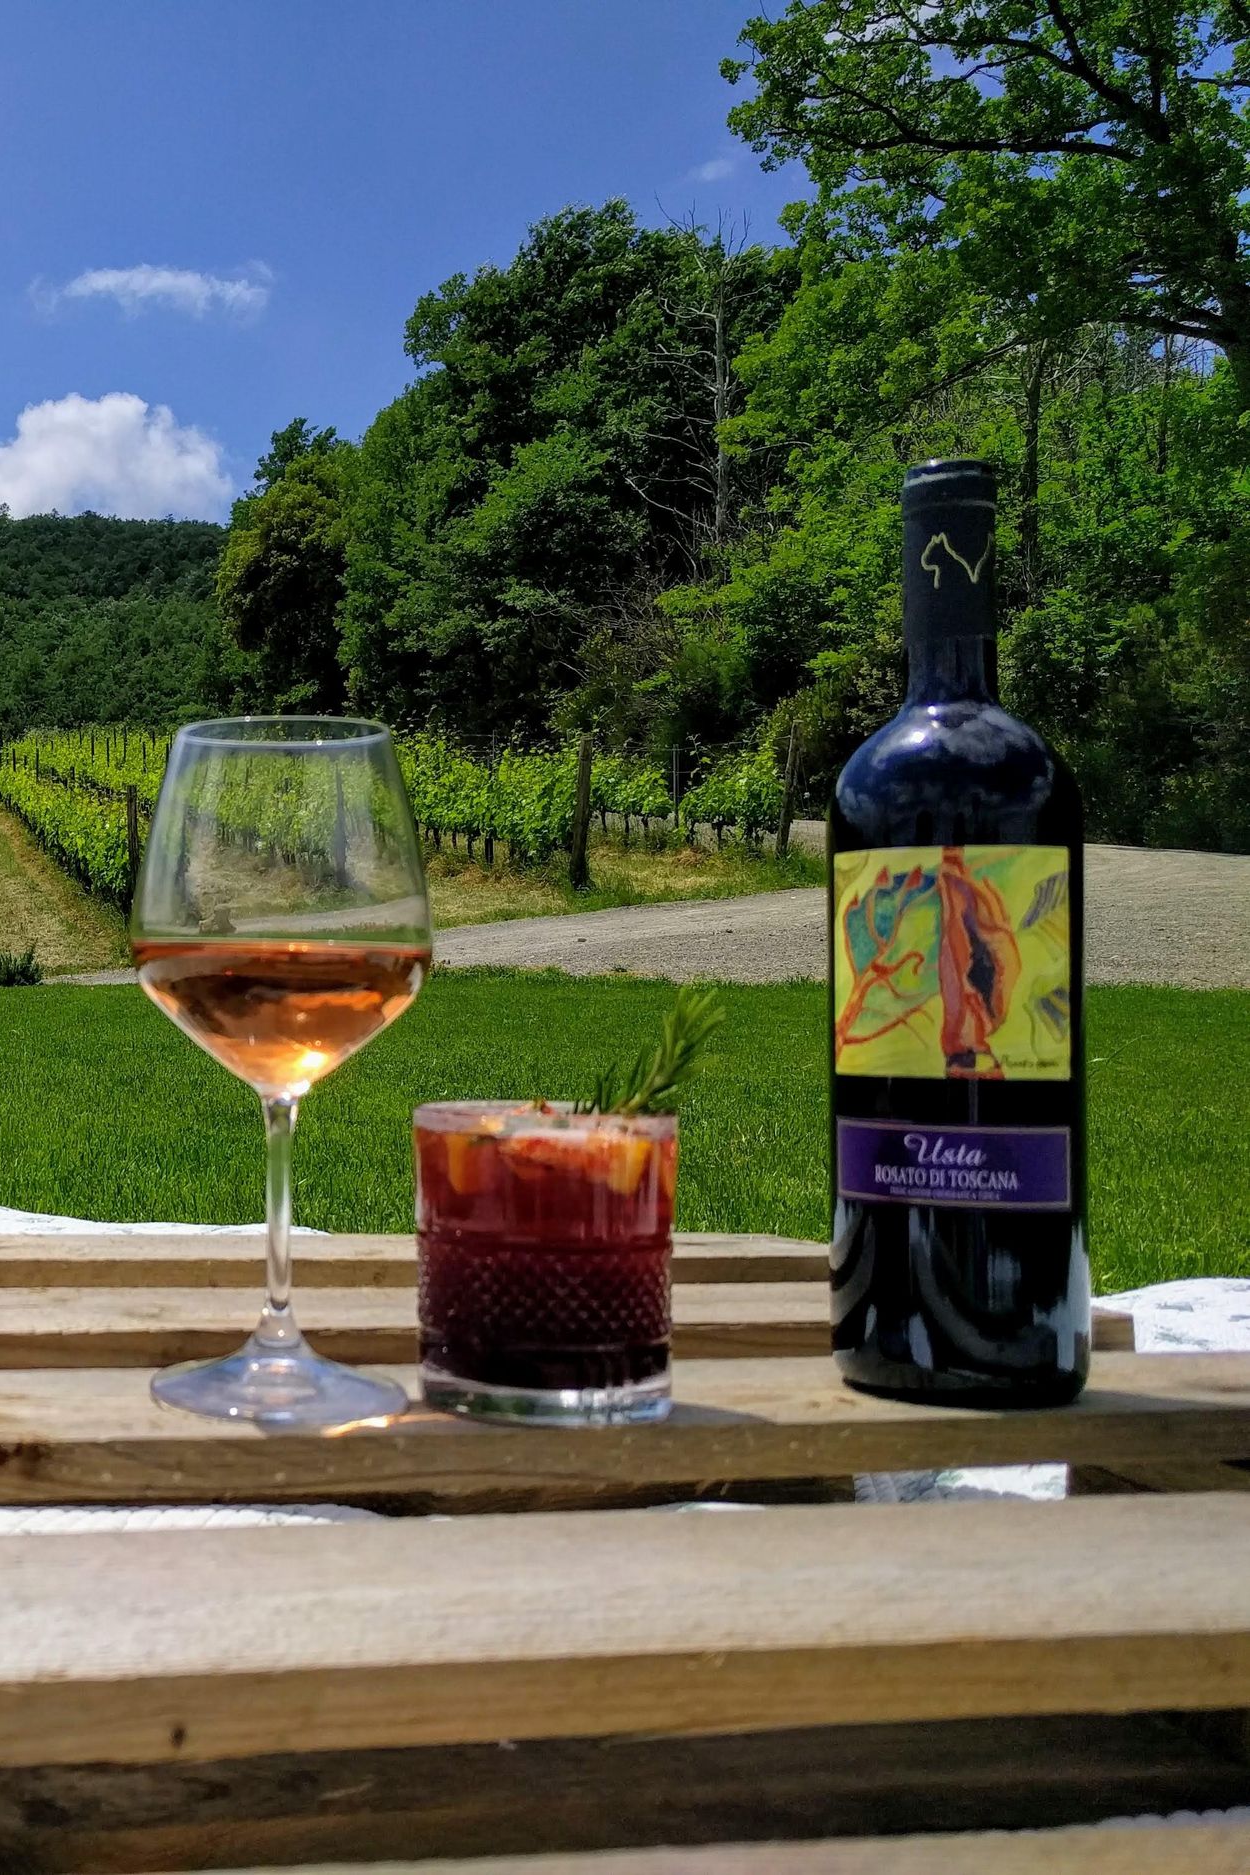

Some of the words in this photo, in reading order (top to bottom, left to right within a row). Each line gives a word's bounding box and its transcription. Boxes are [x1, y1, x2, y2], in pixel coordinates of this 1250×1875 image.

[874, 1164, 926, 1187] ROSATO
[929, 1169, 945, 1187] DI
[948, 1169, 1019, 1191] TOSCANA
